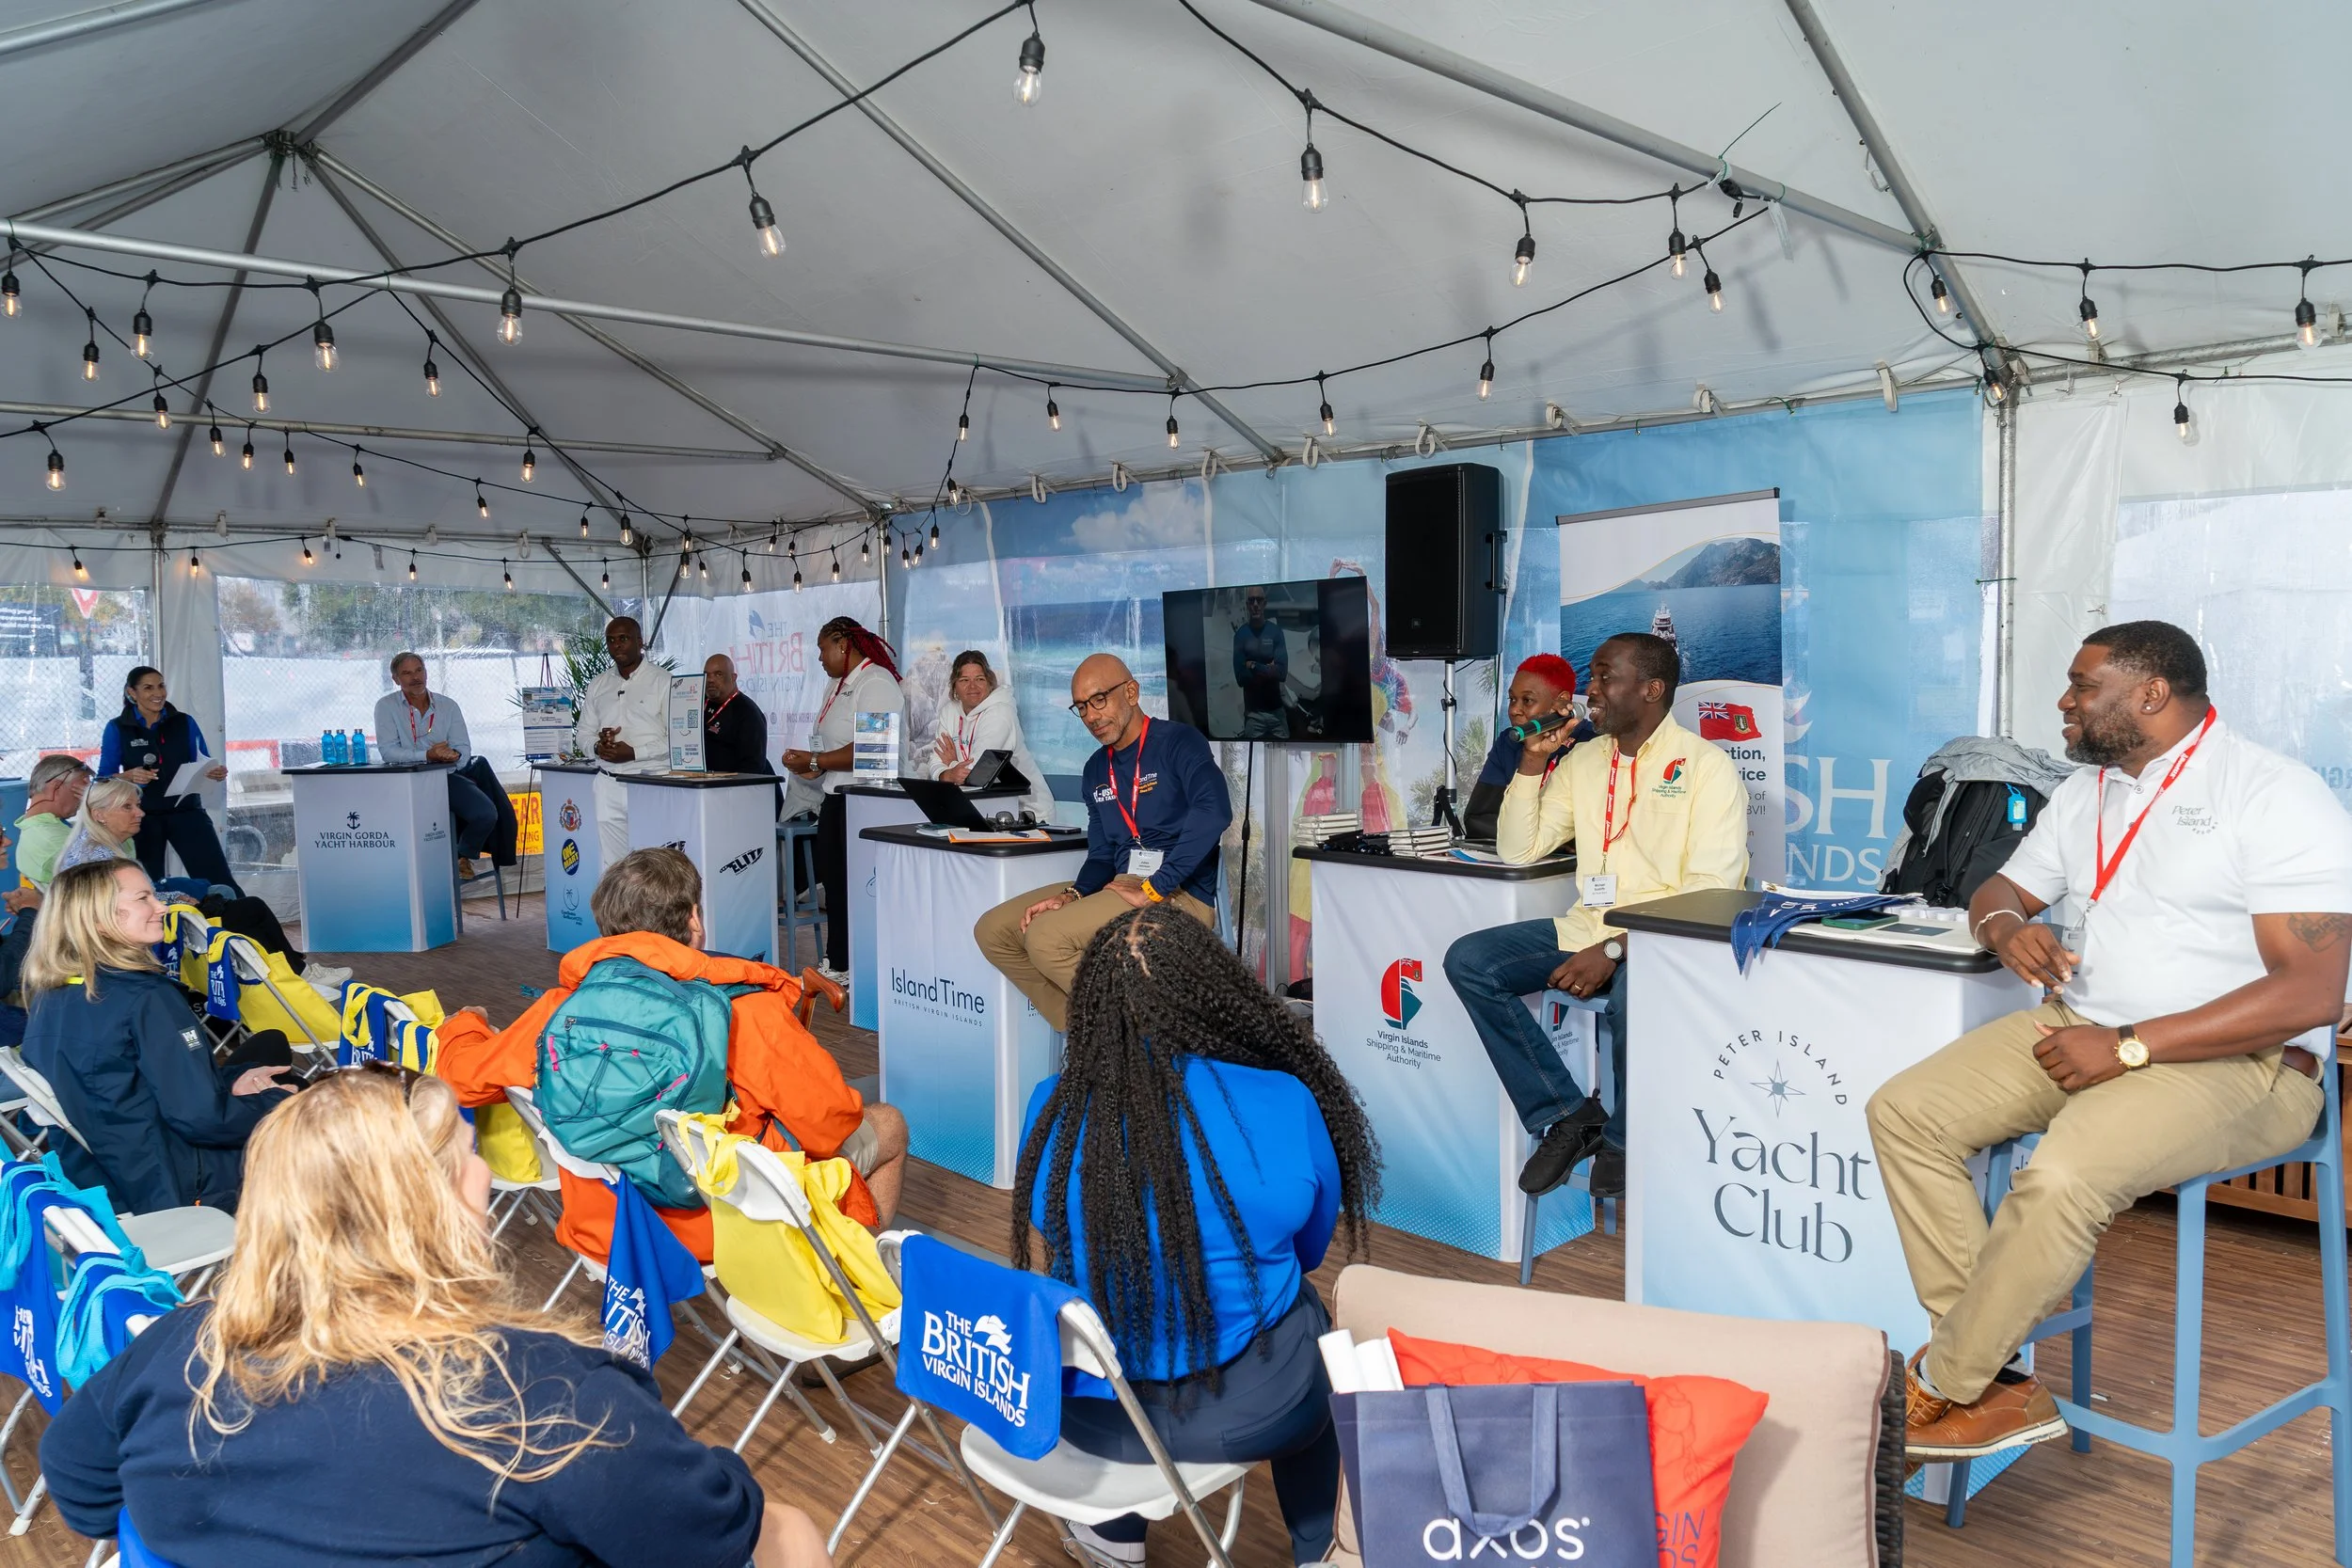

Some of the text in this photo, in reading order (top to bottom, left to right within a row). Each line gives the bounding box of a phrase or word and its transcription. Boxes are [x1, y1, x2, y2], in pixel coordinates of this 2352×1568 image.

[1724, 746, 1767, 762] tion,
[1739, 767, 1767, 781] ice
[1755, 790, 1766, 801] of
[2171, 805, 2205, 816] Peter
[2175, 815, 2212, 827] Island
[314, 840, 396, 848] YACHT HARBOUR
[319, 832, 389, 840] VIRGIN GORDA
[562, 842, 576, 860] ONE
[563, 851, 580, 869] MART
[891, 967, 985, 1014] Island Time
[894, 998, 983, 1027] BRITISH VIRGIN ISLANDS
[1366, 1038, 1441, 1062] Shipping & Maritime
[1377, 1030, 1429, 1049] Virgin Islands
[1386, 1053, 1422, 1069] Authority
[1713, 1029, 1848, 1105] PETER ISLAND
[1692, 1107, 1872, 1200] Yacht
[1714, 1182, 1853, 1263] Club
[609, 1275, 630, 1302] THE
[945, 1309, 973, 1338] THE
[920, 1310, 1031, 1410] BRITISH
[922, 1354, 1026, 1428] VIRGIN ISLANDS
[1655, 1507, 1707, 1546] GIN
